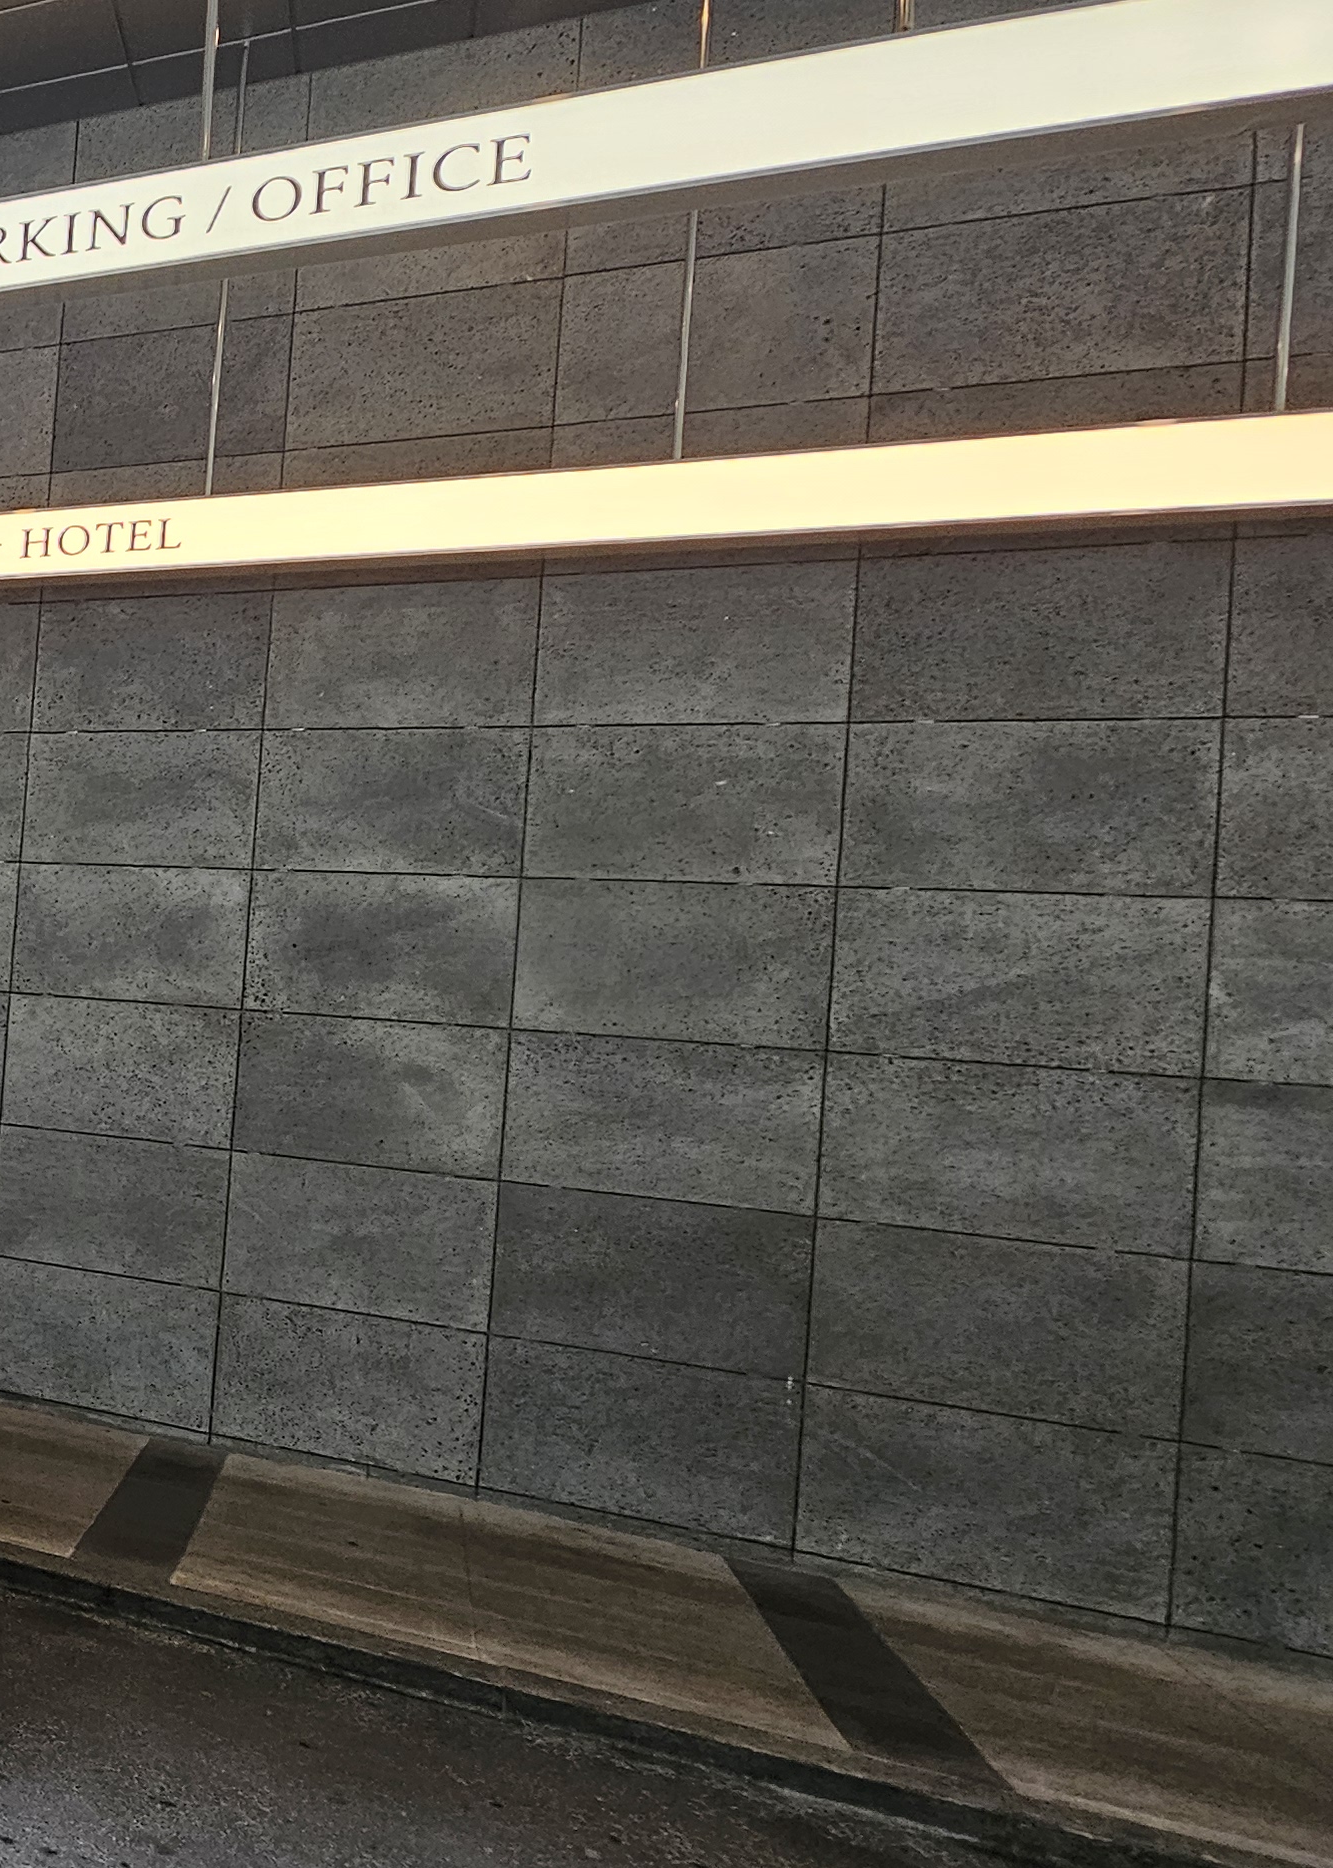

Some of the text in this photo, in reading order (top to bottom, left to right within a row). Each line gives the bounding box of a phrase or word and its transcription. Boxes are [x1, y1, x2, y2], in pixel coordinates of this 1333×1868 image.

[205, 186, 232, 234] /
[251, 133, 532, 222] OFFICE
[19, 517, 182, 559] HOTEL
